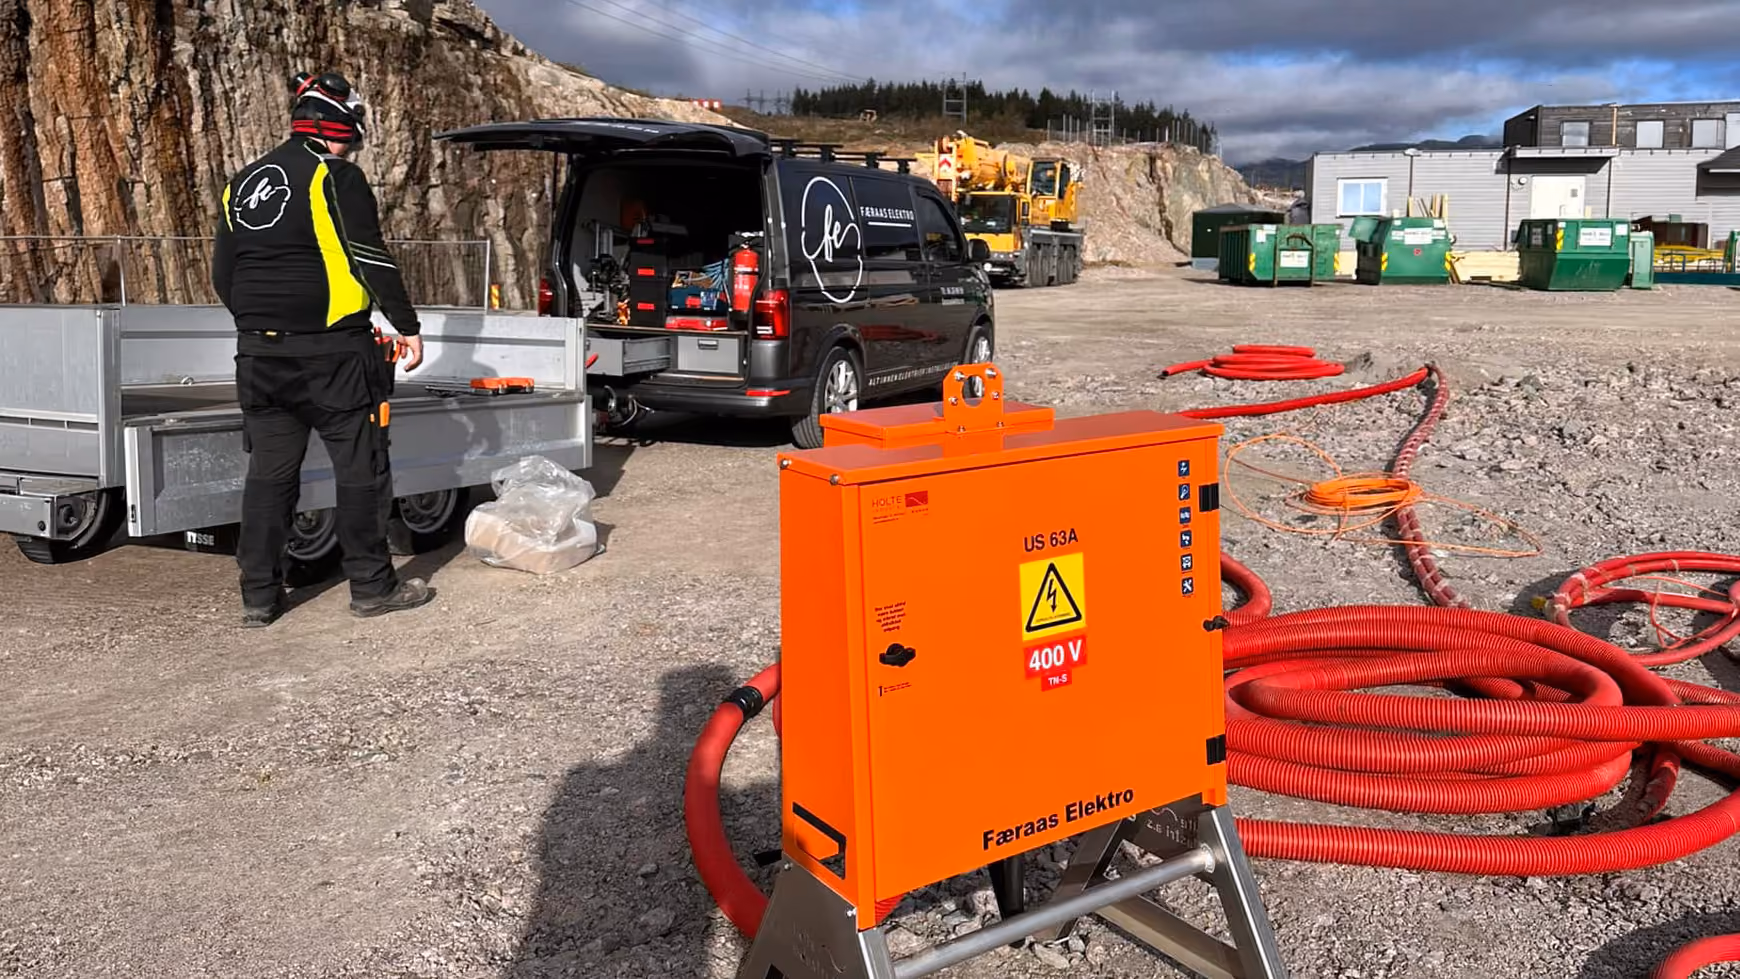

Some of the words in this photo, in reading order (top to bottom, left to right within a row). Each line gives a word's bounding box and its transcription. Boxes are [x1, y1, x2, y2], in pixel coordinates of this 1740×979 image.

[860, 206, 888, 218] FÆRAAS
[888, 208, 914, 220] ELEKTRO
[872, 495, 902, 507] HOLTE
[1023, 534, 1045, 552] US
[1049, 528, 1079, 547] 63A
[1029, 644, 1064, 671] 400
[1068, 639, 1083, 662] V
[1048, 673, 1068, 686] TN-S
[982, 813, 1059, 850] Færaas
[1065, 788, 1134, 822] Elektro
